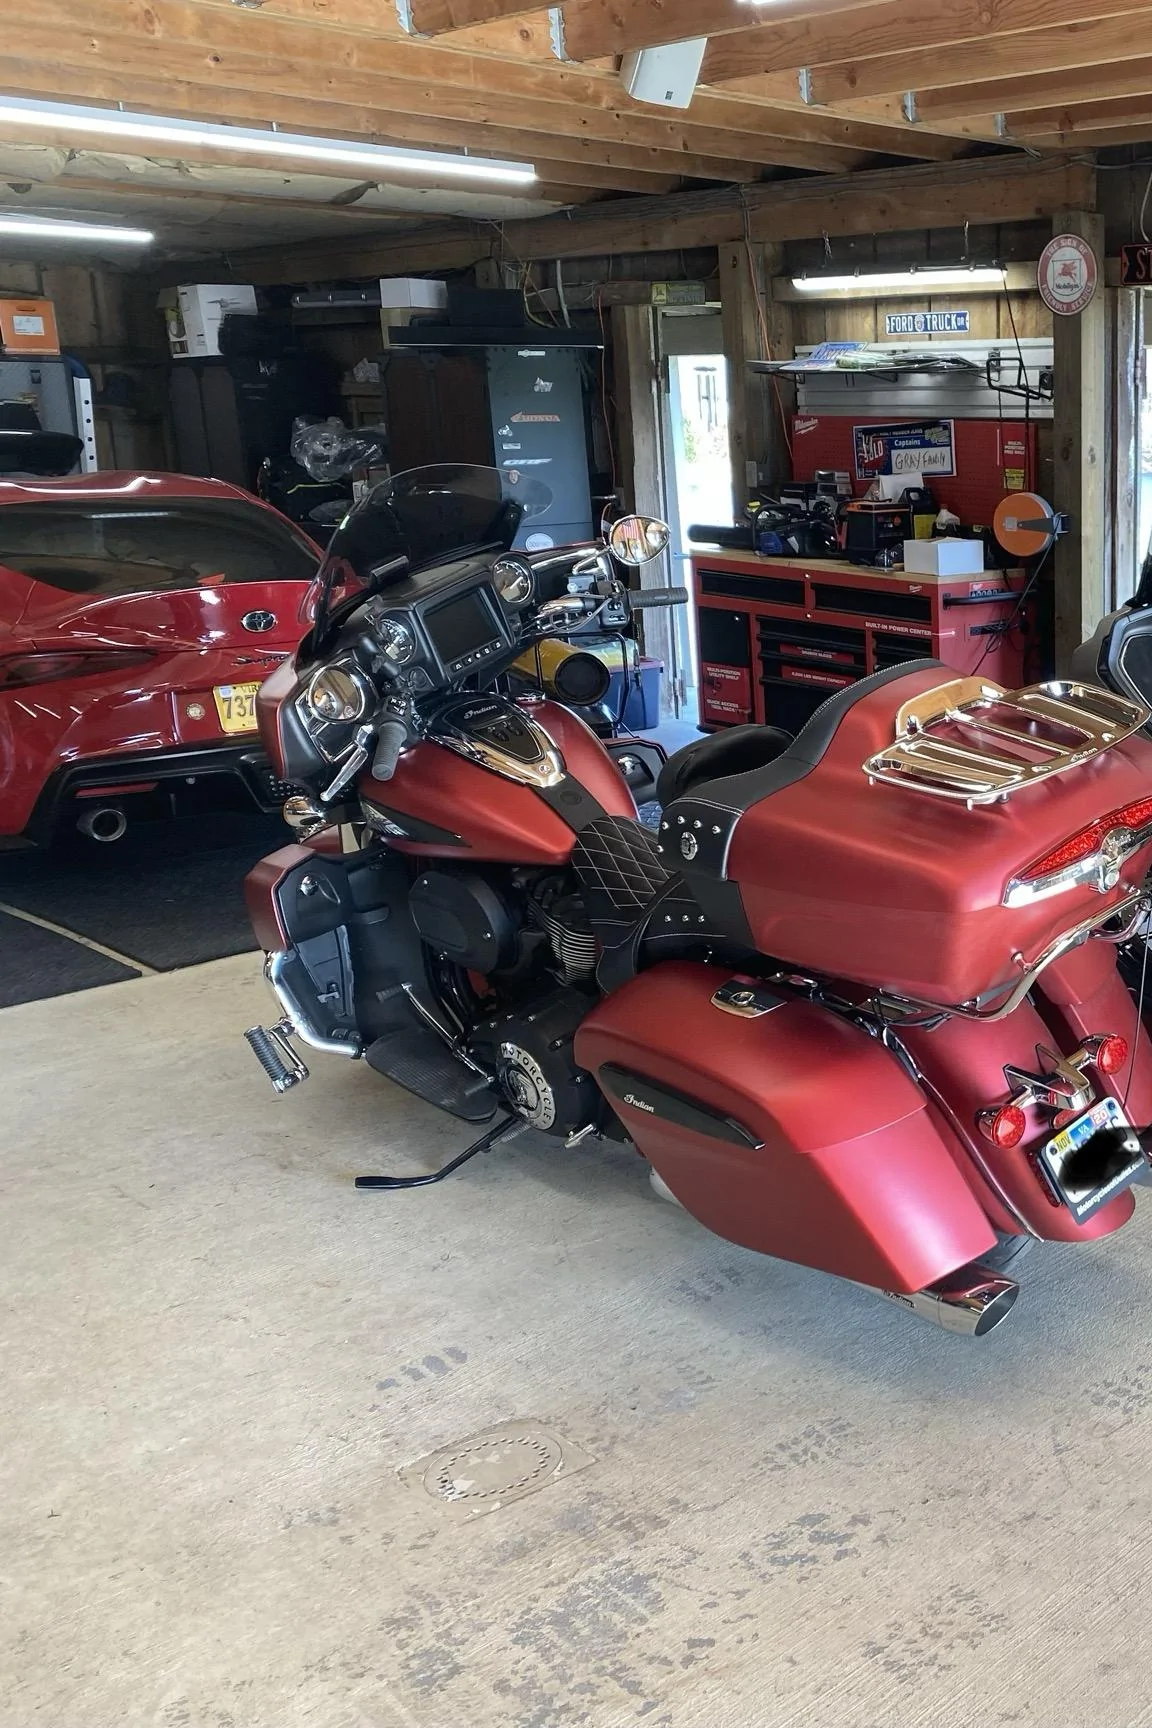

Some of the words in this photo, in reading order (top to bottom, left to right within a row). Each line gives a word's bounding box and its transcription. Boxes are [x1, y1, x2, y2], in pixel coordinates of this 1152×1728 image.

[891, 316, 913, 332] FORD
[925, 314, 957, 330] TRUCK
[894, 439, 920, 447] Captains
[895, 452, 921, 469] GRAY
[241, 684, 260, 693] VIR
[464, 704, 498, 719] Indian
[502, 1044, 552, 1121] MOTORCYCLE
[623, 1094, 655, 1113] Indian
